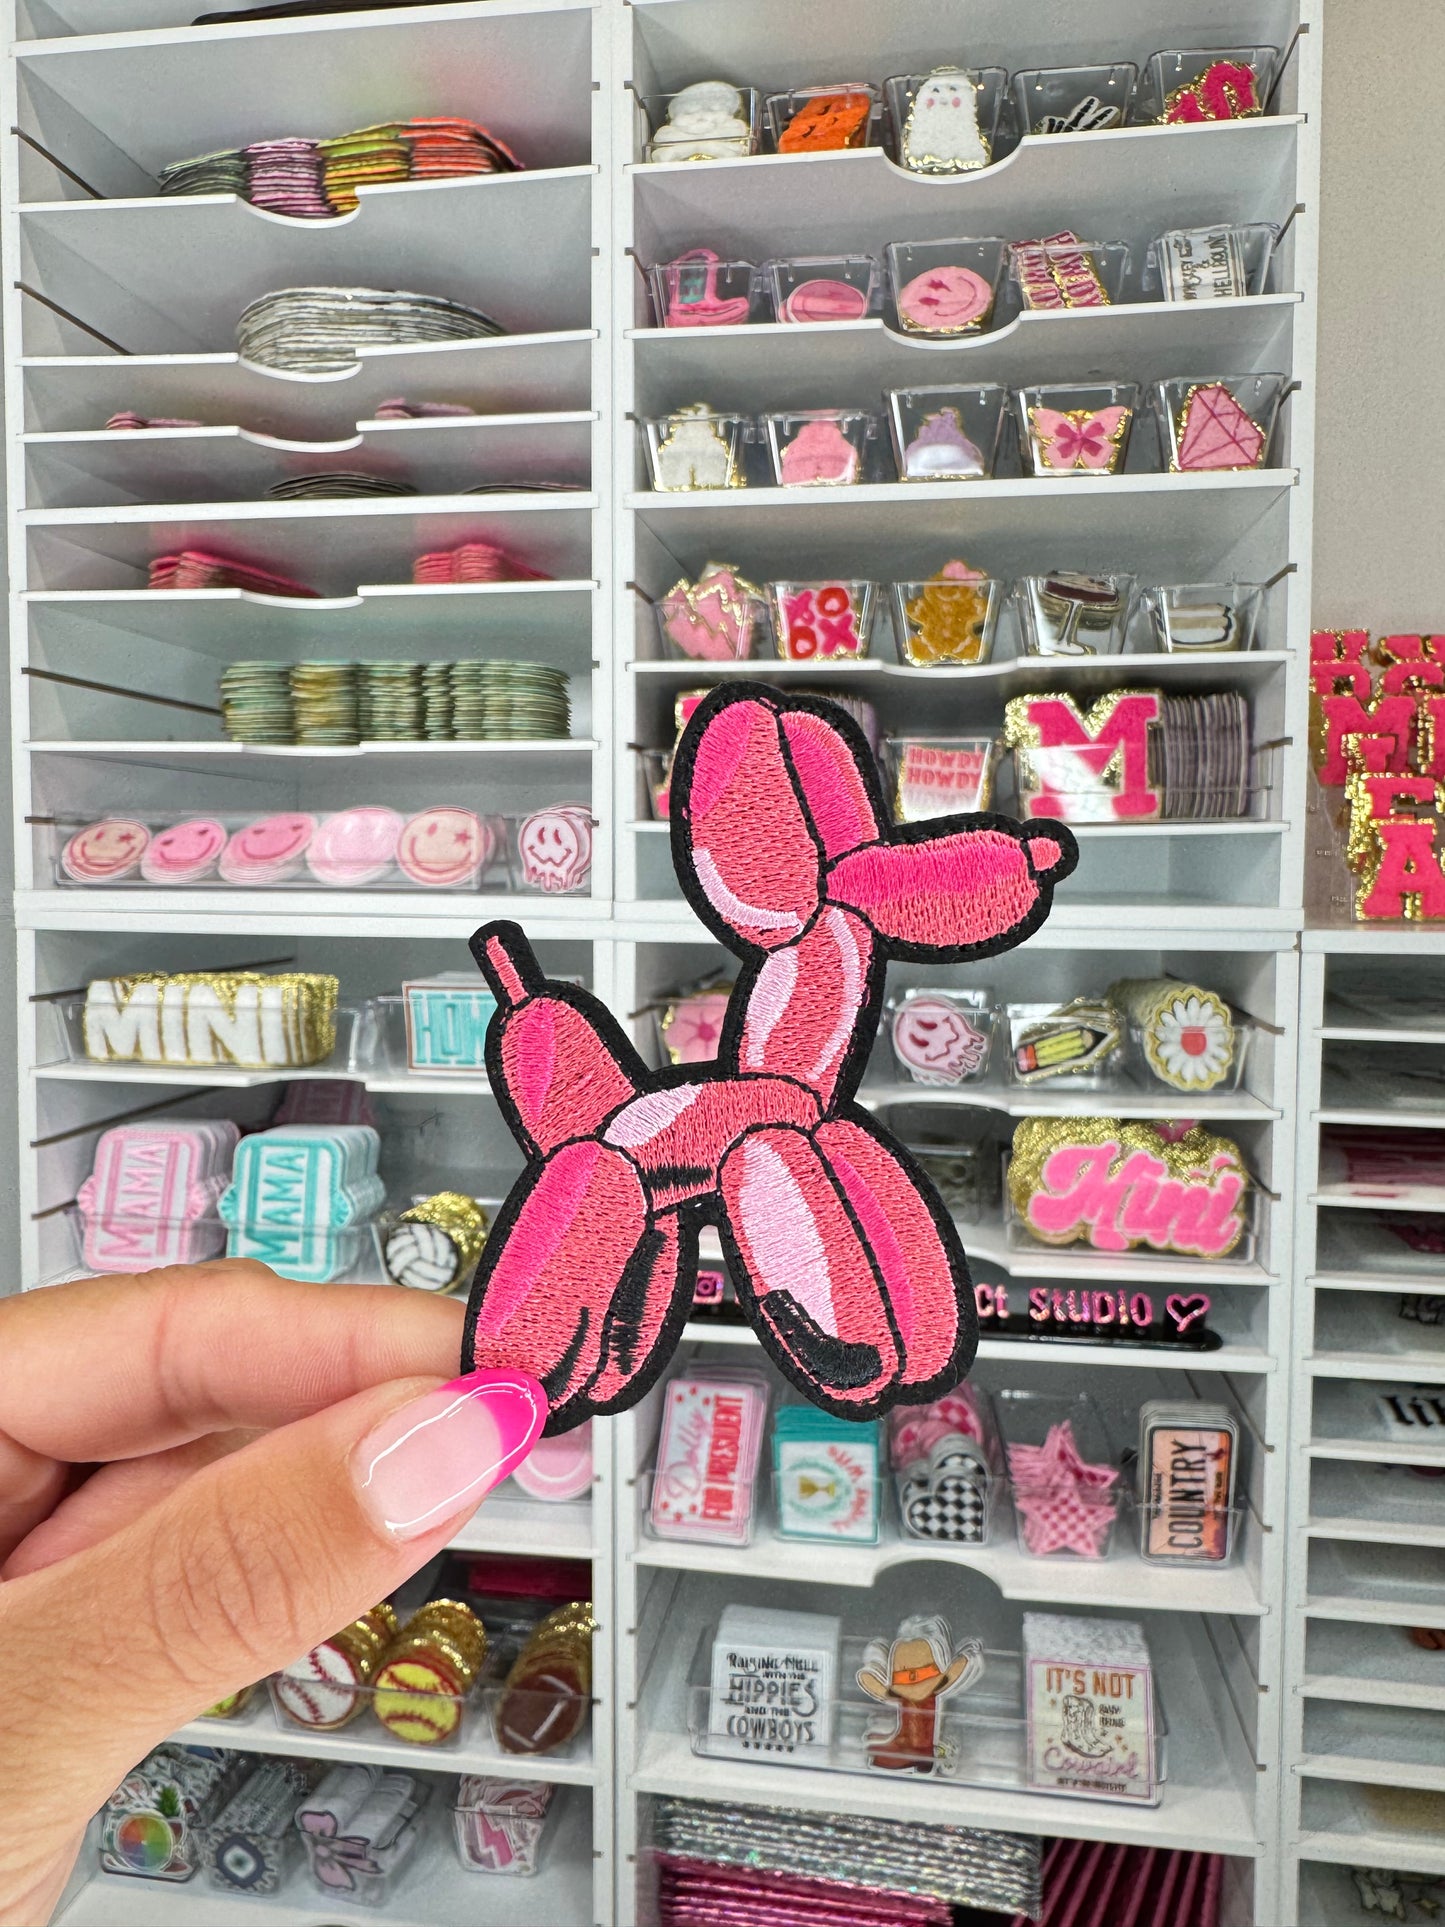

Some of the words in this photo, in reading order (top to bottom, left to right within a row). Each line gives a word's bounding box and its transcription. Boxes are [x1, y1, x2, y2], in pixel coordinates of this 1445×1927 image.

[904, 766, 982, 789] HOWDY
[907, 747, 985, 769] HOWDY
[86, 979, 286, 1065] MINI
[412, 993, 497, 1065] HOW
[98, 1142, 168, 1259] MAMA
[244, 1149, 305, 1265] MAMA
[1028, 1142, 1242, 1255] Mini
[1167, 1438, 1208, 1549] COUNTRY
[722, 1679, 819, 1718] HIPPIES
[1045, 1667, 1087, 1695] IT'S
[1092, 1670, 1136, 1700] NOT
[726, 1714, 817, 1742] COWBOYS
[744, 1706, 767, 1716] AND
[770, 1706, 790, 1717] THE
